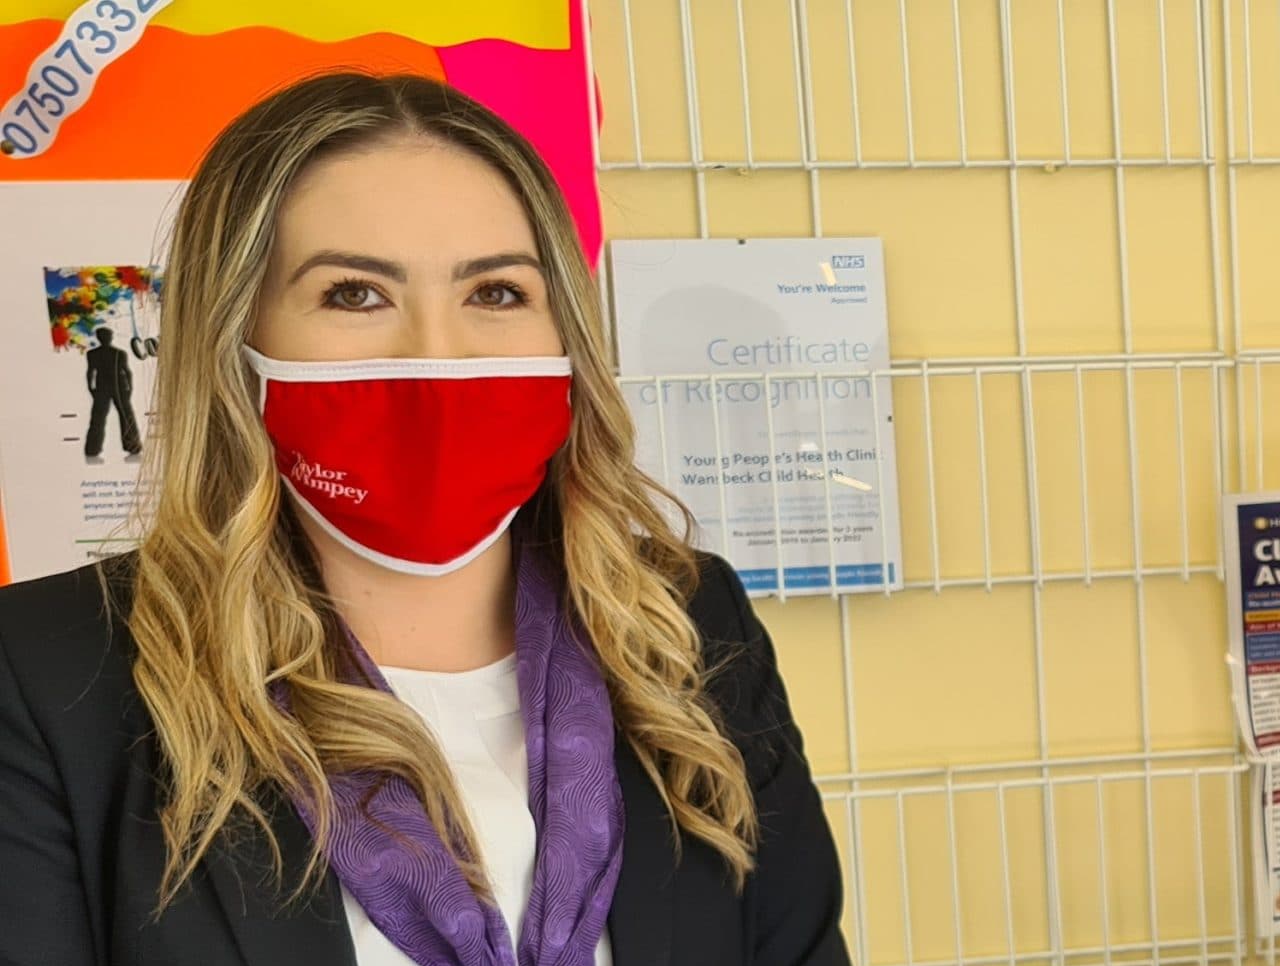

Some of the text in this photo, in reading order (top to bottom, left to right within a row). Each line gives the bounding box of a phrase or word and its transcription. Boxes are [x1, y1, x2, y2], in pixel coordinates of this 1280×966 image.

[3, 0, 157, 154] 0750733
[832, 255, 865, 269] NHS
[777, 283, 867, 294] You're Welcome
[706, 335, 871, 366] Certificate
[685, 376, 872, 409] Recogniion
[734, 451, 792, 467] Peope's
[797, 449, 843, 463] Heath
[846, 448, 884, 462] Clini
